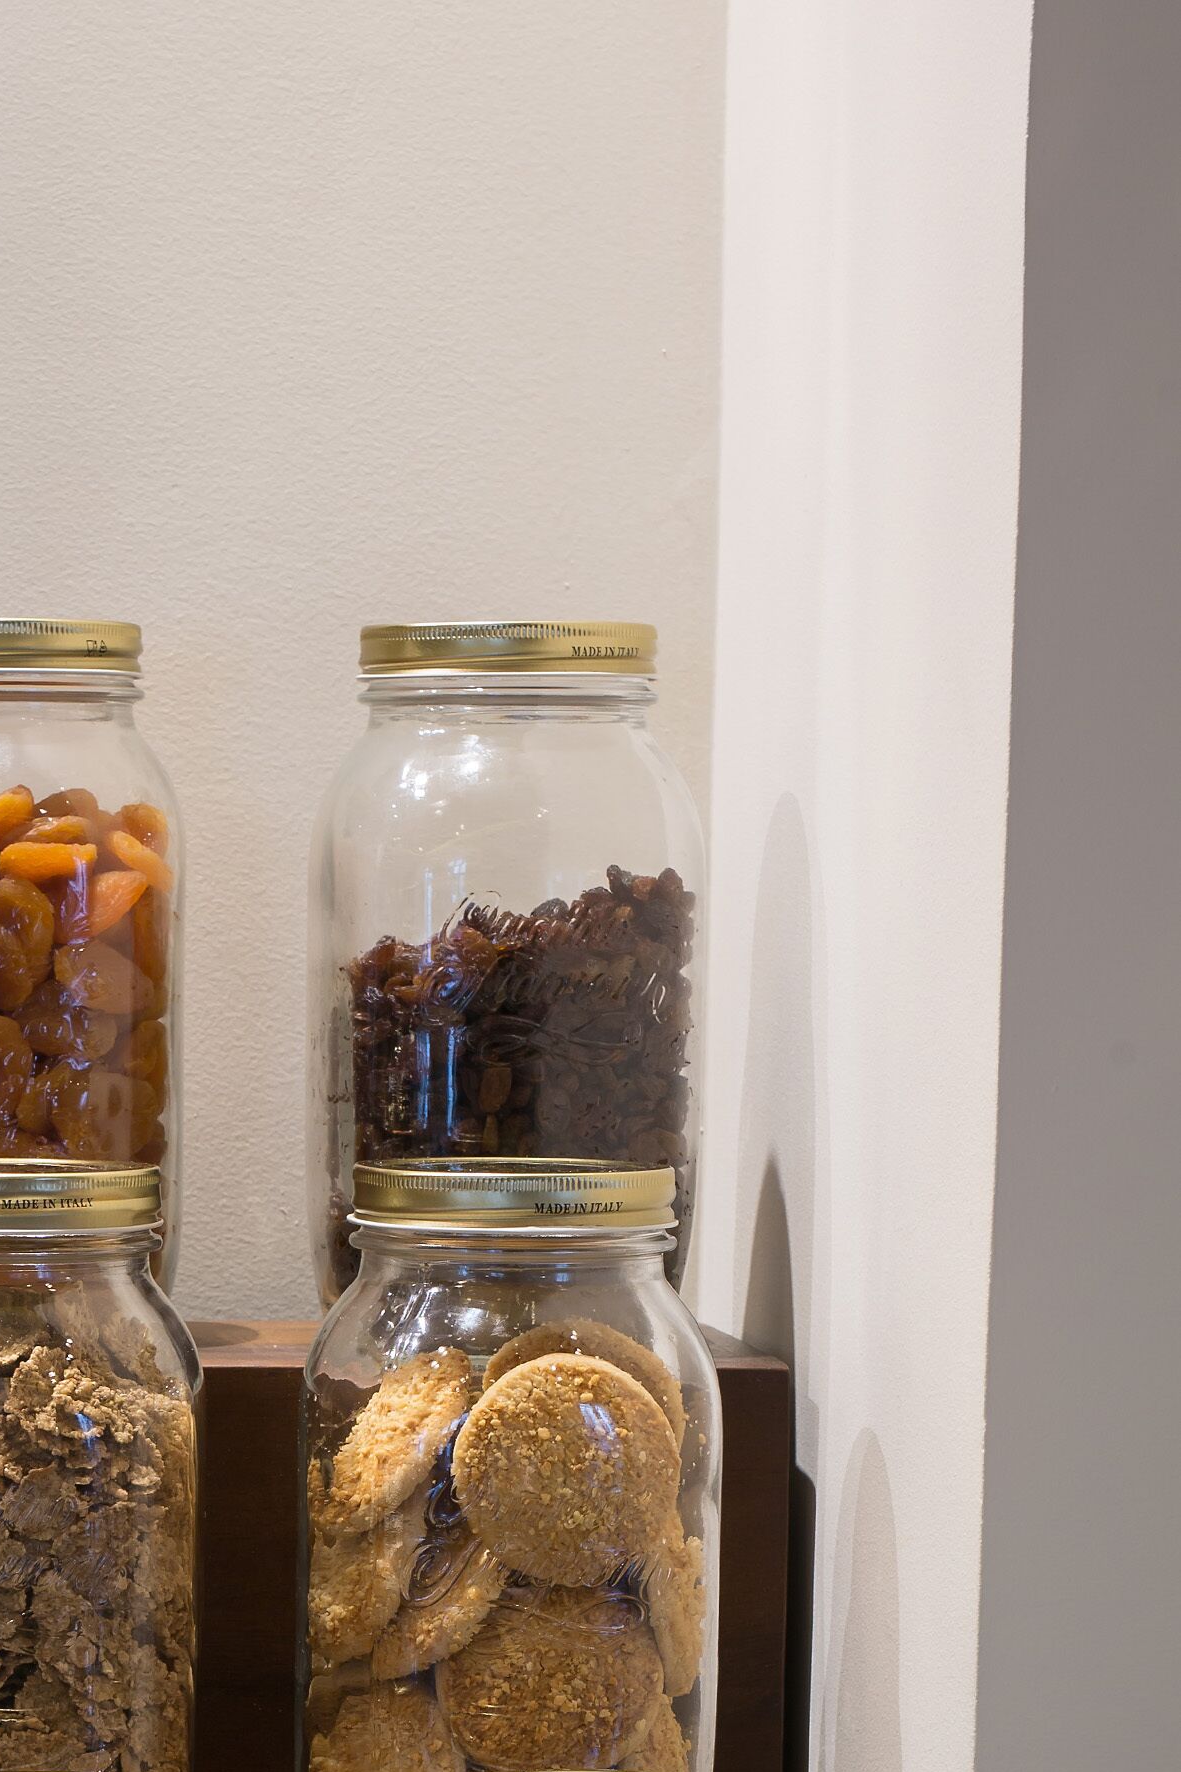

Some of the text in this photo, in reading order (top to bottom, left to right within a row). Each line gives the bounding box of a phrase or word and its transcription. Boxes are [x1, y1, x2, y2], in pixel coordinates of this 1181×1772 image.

[571, 646, 640, 657] MADE IN ITALY
[1, 1197, 94, 1210] MADE IN ITALY
[534, 1201, 623, 1214] MADE IN ITALY
